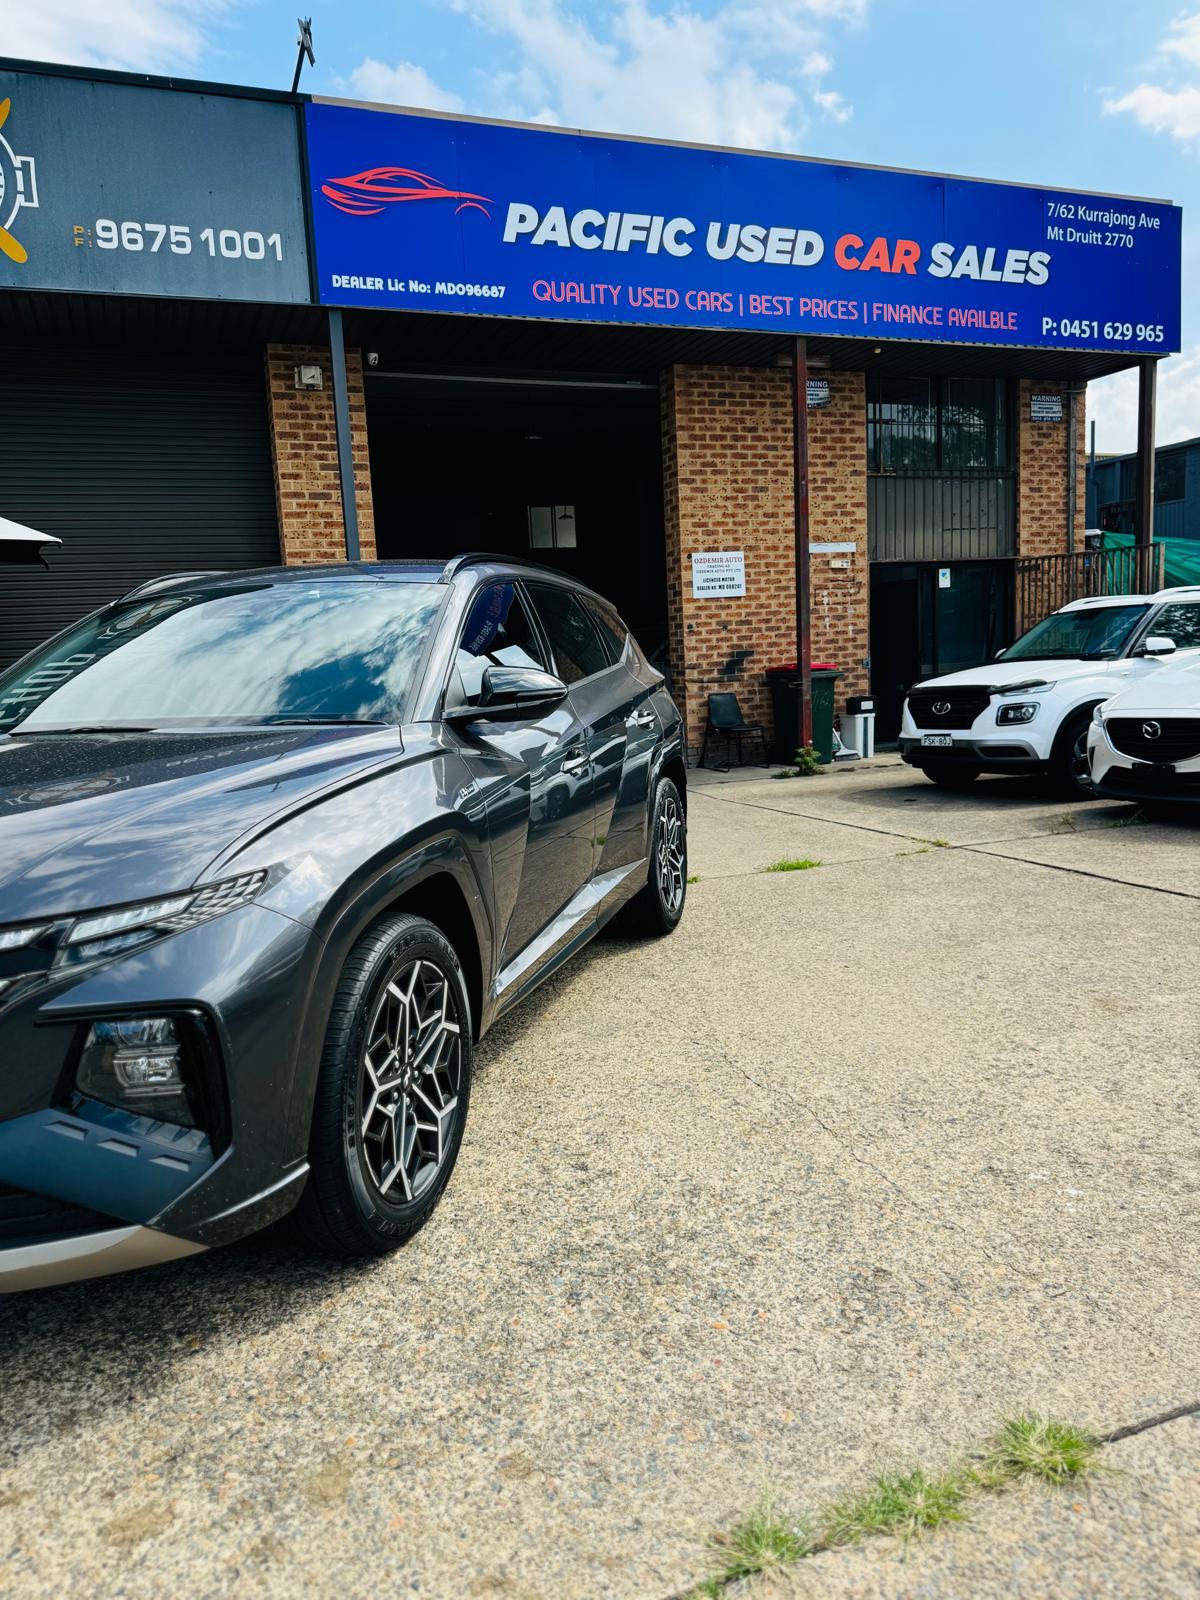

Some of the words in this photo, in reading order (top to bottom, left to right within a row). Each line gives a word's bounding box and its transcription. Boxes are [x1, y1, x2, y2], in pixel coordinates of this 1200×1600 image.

[1047, 203, 1075, 219] 7/62
[1078, 206, 1136, 230] Kurrajong
[1139, 213, 1160, 229] Ave
[96, 219, 192, 255] 9675
[200, 228, 283, 261] 1001
[502, 202, 696, 257] PACIFIC
[705, 222, 825, 266] USED
[834, 234, 921, 275] CAR
[927, 242, 1051, 286] SALES
[1047, 226, 1064, 241] Mt
[1067, 228, 1102, 245] Druitt
[1105, 232, 1134, 248] 2770
[332, 275, 384, 290] DEALER
[388, 279, 405, 292] Lic
[409, 280, 431, 294] No:
[532, 279, 622, 306] QUALITY
[628, 286, 679, 309] USED
[685, 290, 733, 312] CARS
[749, 294, 794, 316] BEST
[799, 298, 859, 321] PRICES
[872, 303, 943, 326] FINANCE
[948, 307, 1018, 331] AVAILBLE
[1060, 319, 1098, 339] 0451
[1104, 322, 1133, 340] 629
[1136, 324, 1164, 343] 965
